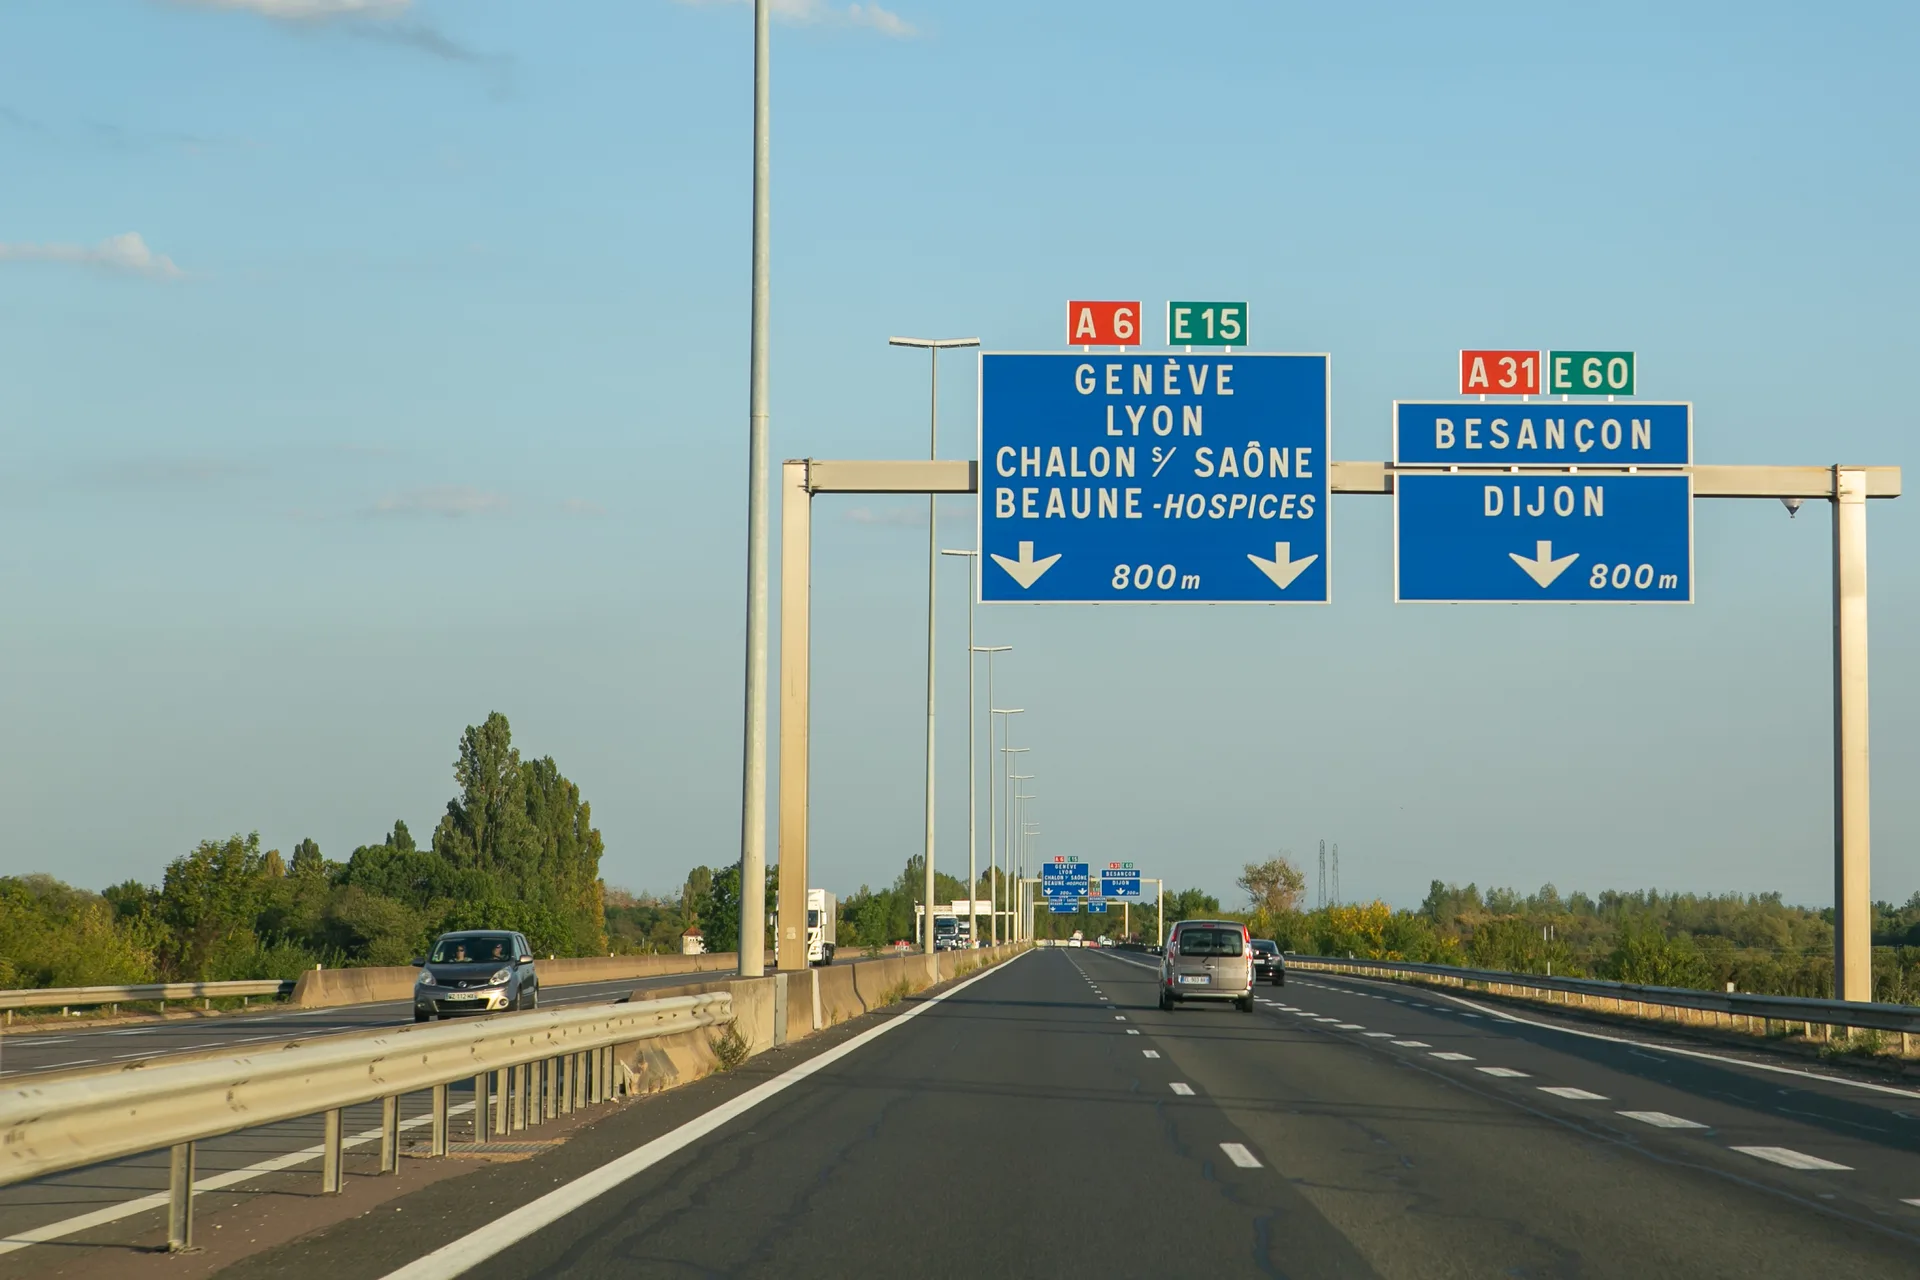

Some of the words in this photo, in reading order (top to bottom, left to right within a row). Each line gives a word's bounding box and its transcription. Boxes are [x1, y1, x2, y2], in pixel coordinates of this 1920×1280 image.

[1075, 307, 1097, 339] A
[1113, 307, 1134, 339] 6
[1075, 359, 1234, 395] GENÈVE
[1107, 405, 1203, 437] LYON
[1435, 418, 1651, 453] BESANÇON
[996, 445, 1135, 478] CHALON
[1194, 440, 1313, 478] SAÔNE
[996, 487, 1143, 519] BEAUNE
[1484, 485, 1604, 517] DIJON
